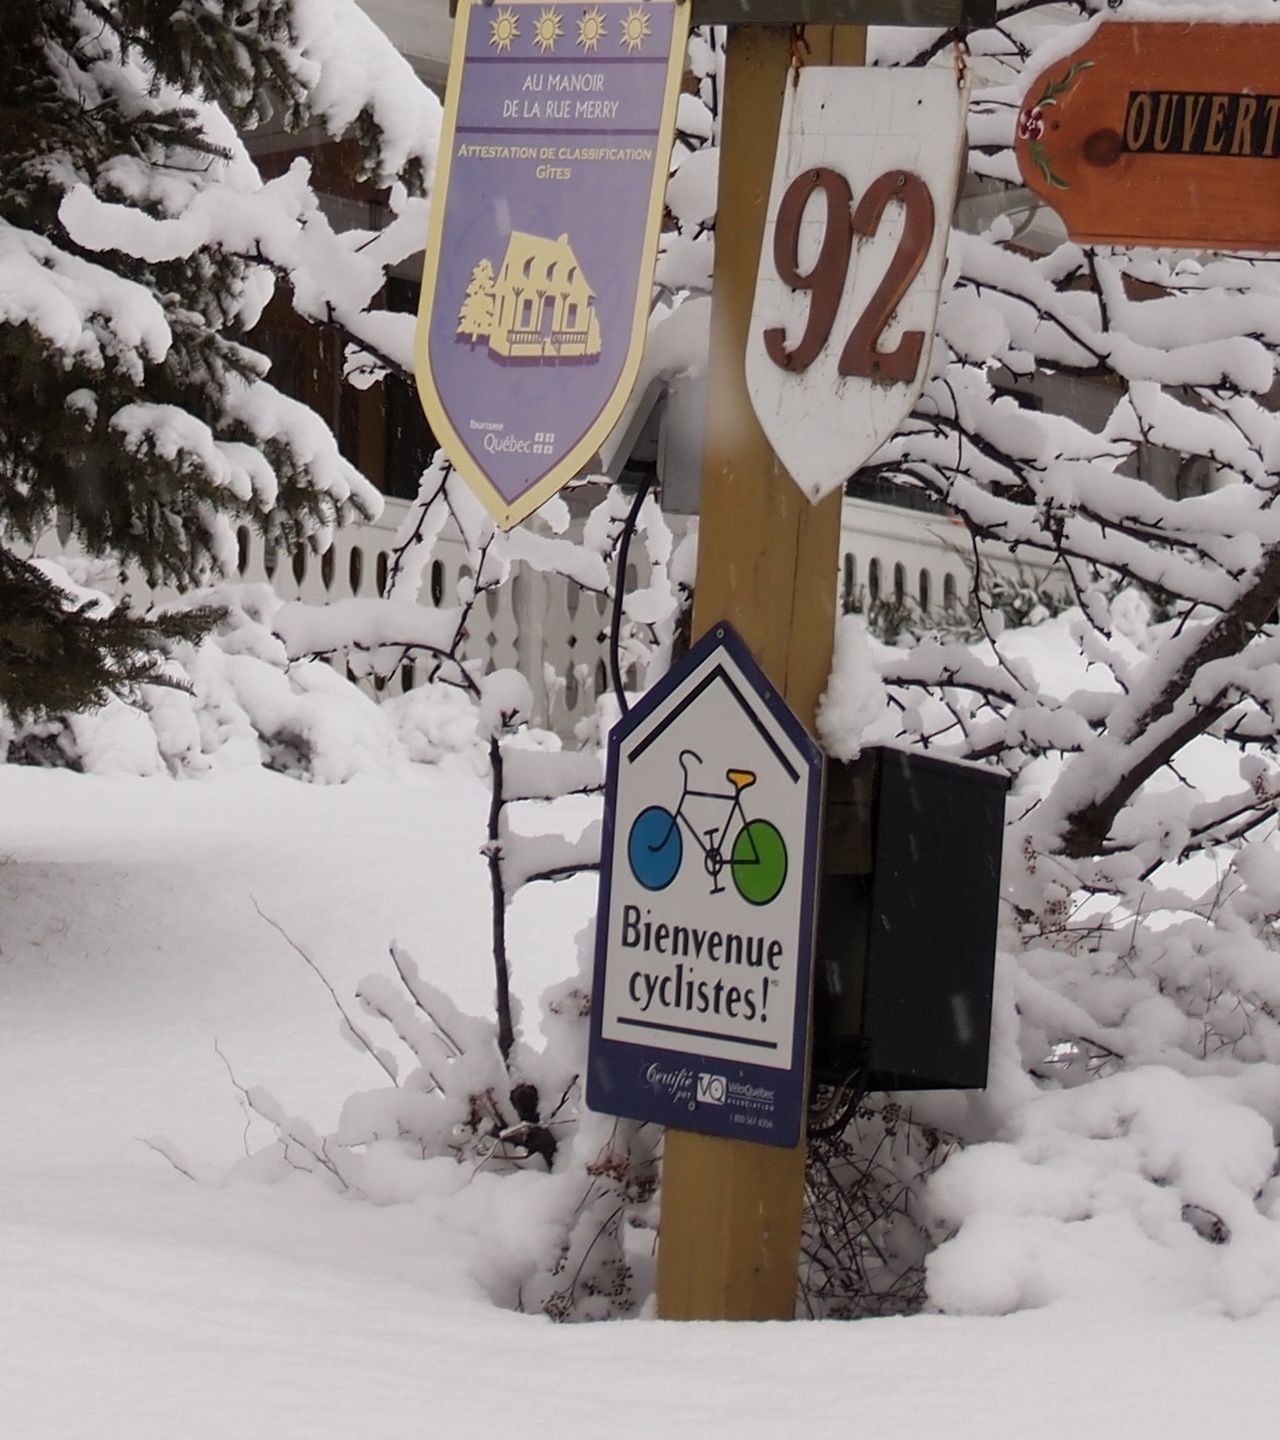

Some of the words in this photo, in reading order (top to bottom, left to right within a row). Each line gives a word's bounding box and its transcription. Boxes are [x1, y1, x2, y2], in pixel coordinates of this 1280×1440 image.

[522, 73, 543, 92] AU
[547, 73, 605, 92] MANOIR
[503, 99, 519, 118] DE
[523, 100, 540, 118] LA
[545, 100, 571, 119] RUE
[575, 100, 619, 119] MERRY
[539, 147, 556, 160] DE
[763, 167, 935, 384] 92
[483, 433, 532, 455] Québec
[622, 904, 783, 972] Bienvenue
[628, 963, 770, 1024] cyclistes!
